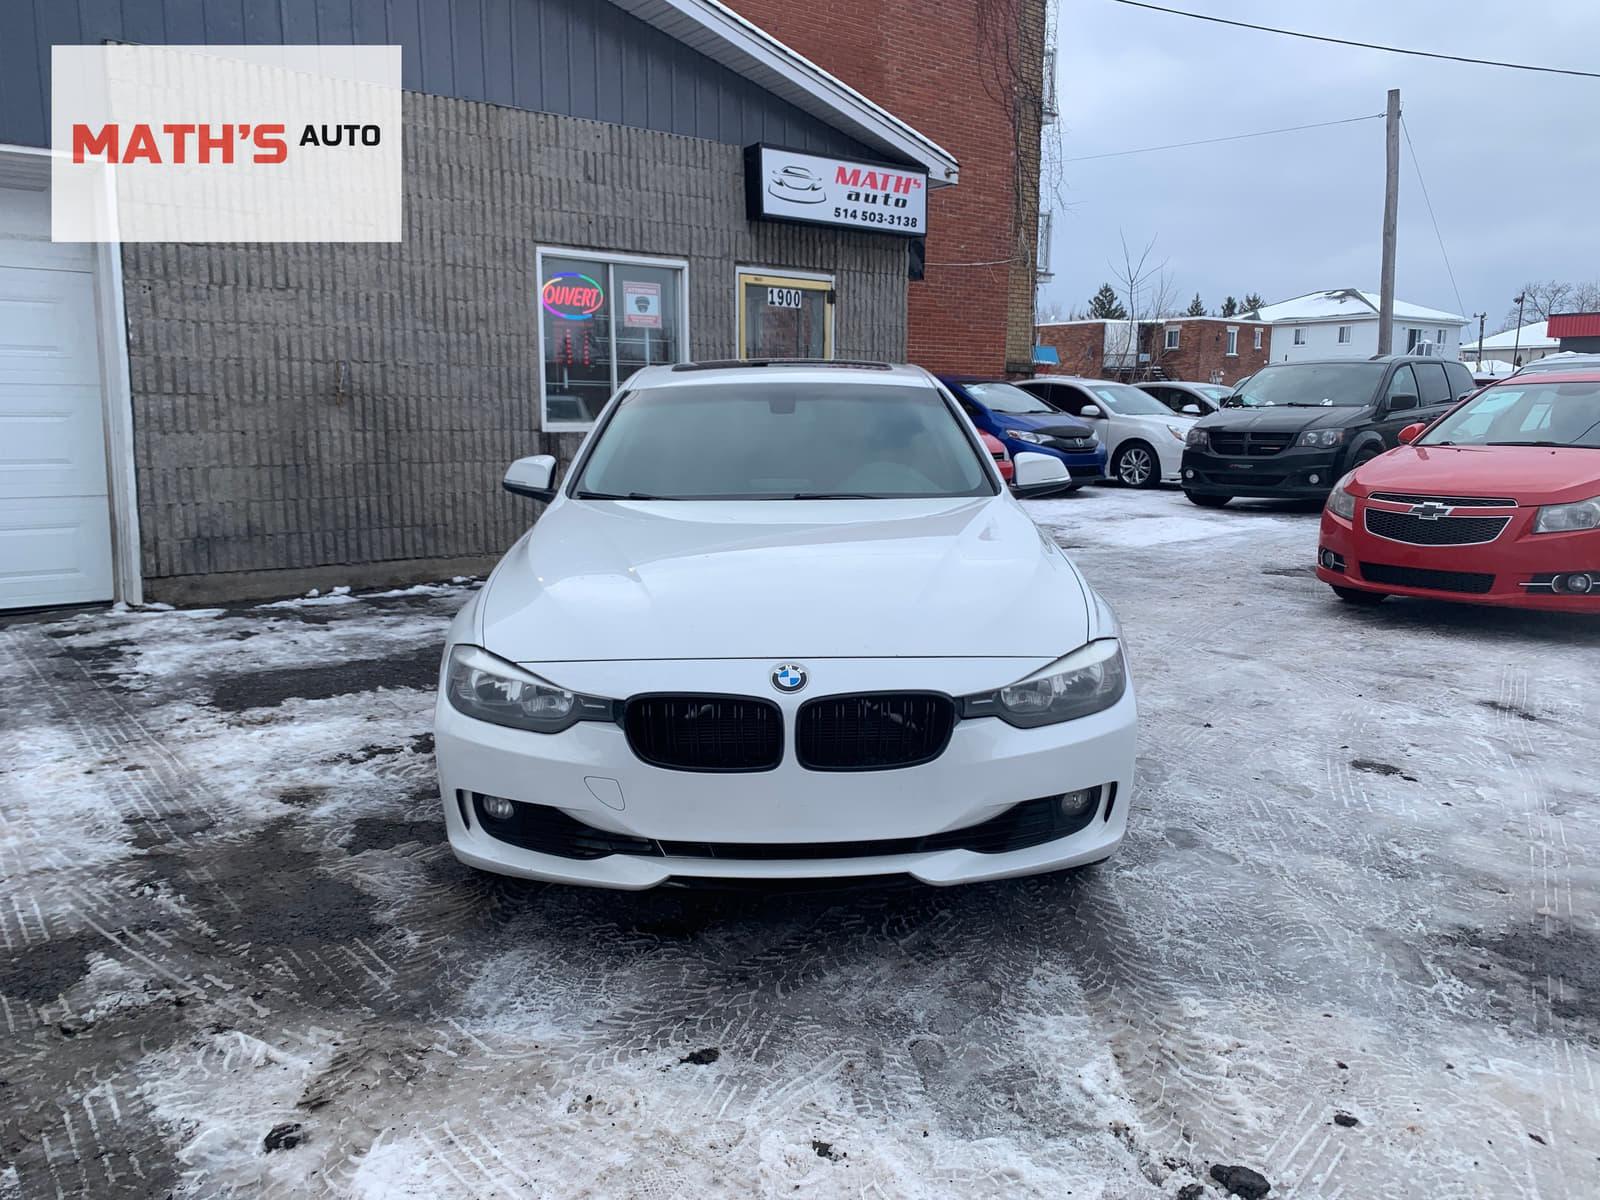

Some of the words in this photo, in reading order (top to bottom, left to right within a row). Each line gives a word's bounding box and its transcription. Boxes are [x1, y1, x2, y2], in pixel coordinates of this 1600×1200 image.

[846, 190, 908, 208] auto
[833, 207, 858, 220] 514
[861, 211, 918, 228] 503-3138
[543, 285, 599, 308] OUVERT
[769, 288, 800, 307] 1900
